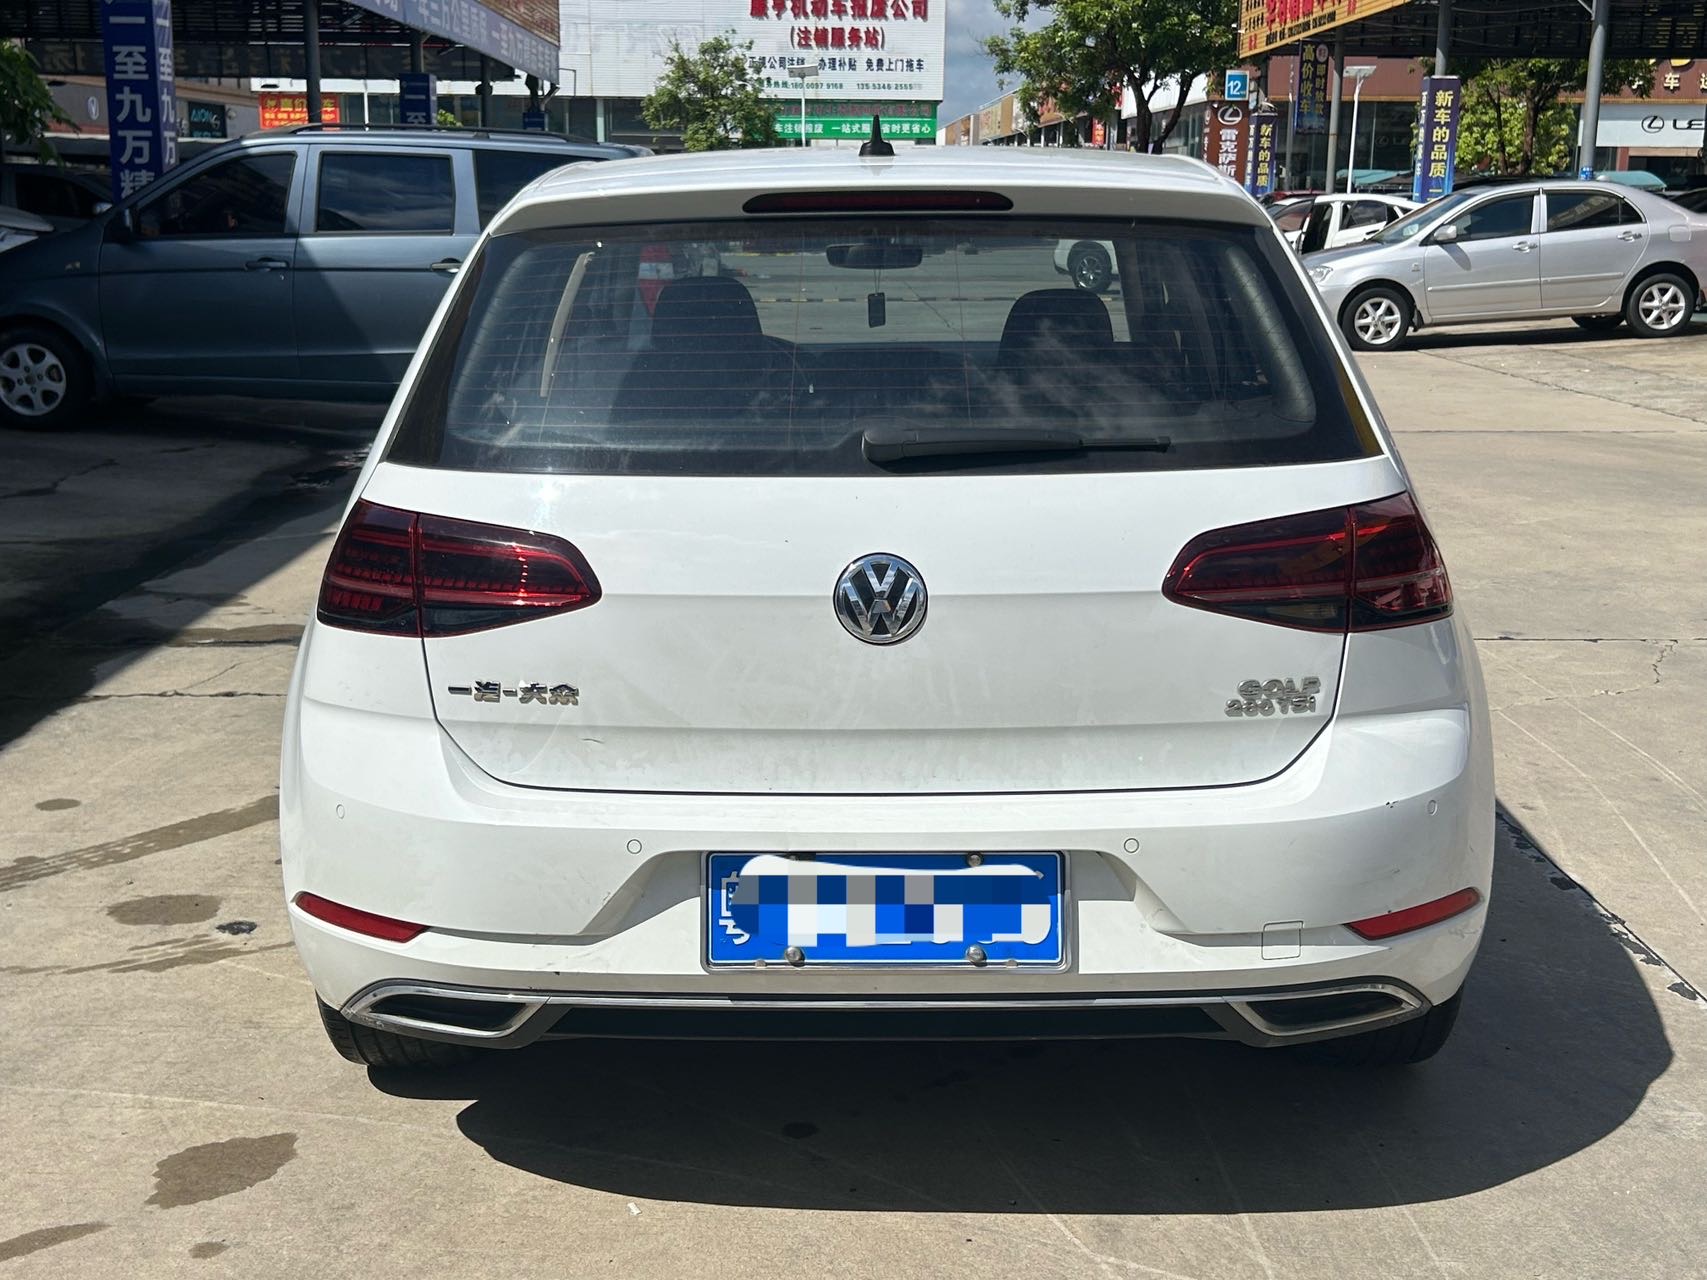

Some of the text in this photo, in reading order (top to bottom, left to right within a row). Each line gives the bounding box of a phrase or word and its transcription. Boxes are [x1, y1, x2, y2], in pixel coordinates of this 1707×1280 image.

[1217, 128, 1239, 177] 雷克萨斯
[1237, 676, 1321, 701] GOLF
